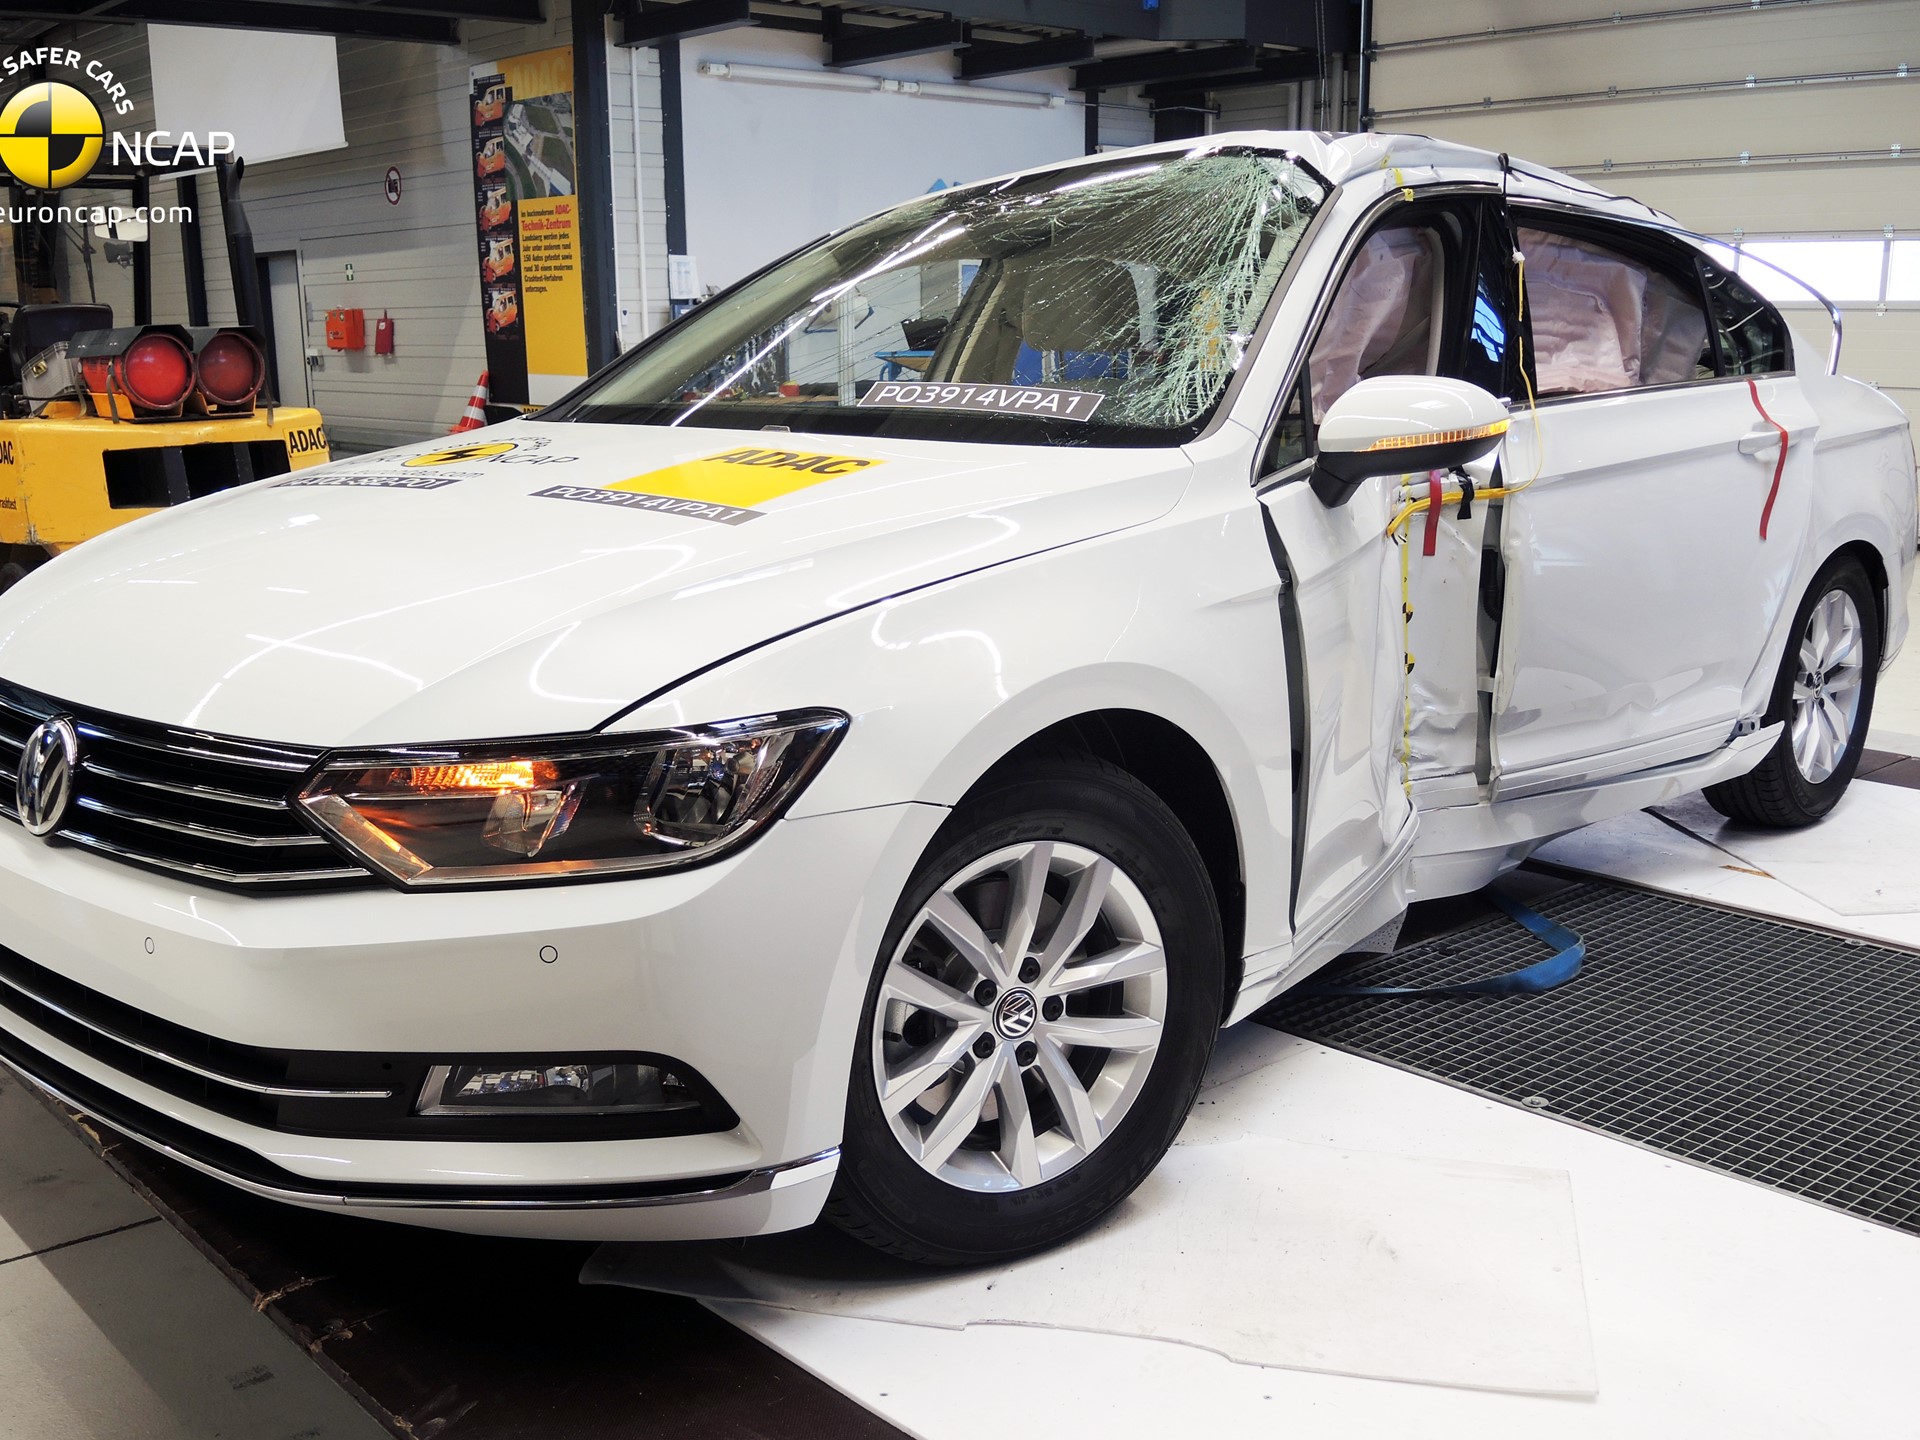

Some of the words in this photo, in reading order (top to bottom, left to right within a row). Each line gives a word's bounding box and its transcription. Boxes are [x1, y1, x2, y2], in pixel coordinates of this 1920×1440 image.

[521, 218, 572, 231] Technik-Zentrum
[522, 233, 543, 242] Landsberg
[558, 231, 570, 241] jedes
[532, 254, 544, 262] Autos
[288, 426, 327, 454] ADAC
[476, 453, 579, 465] NCAP
[701, 449, 871, 475] ADAC
